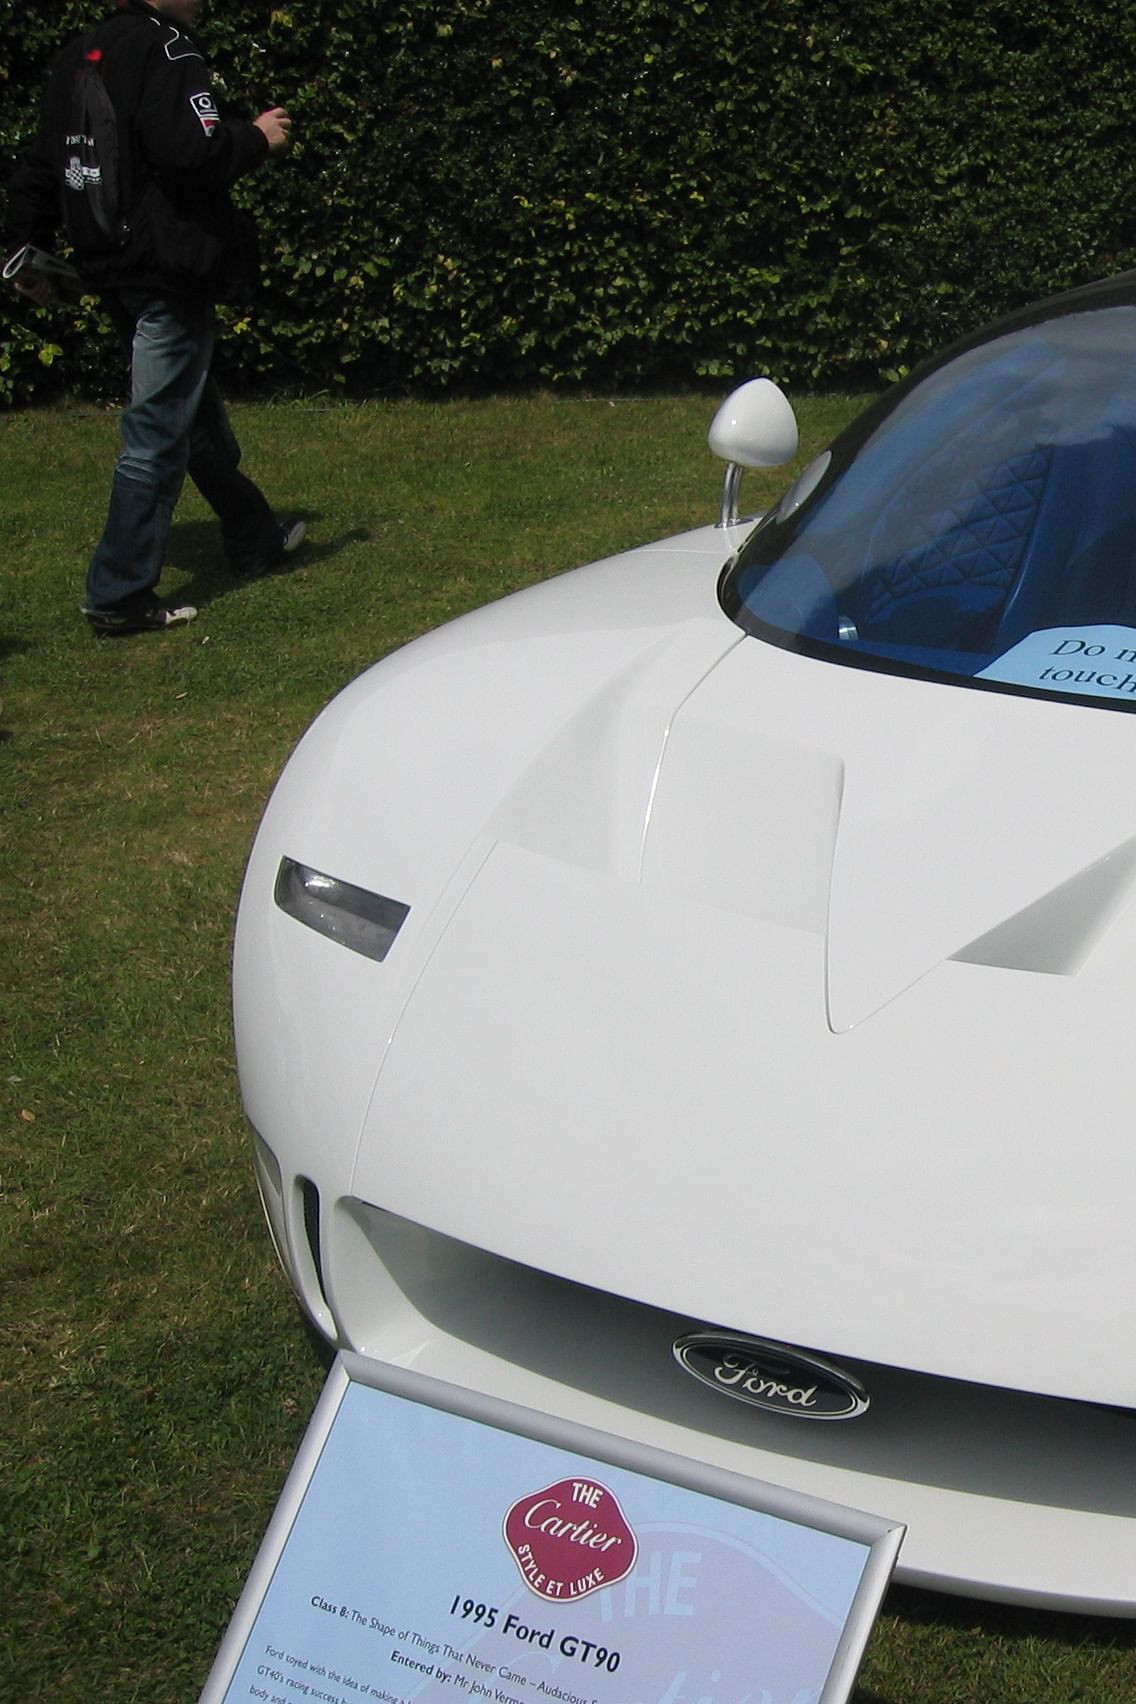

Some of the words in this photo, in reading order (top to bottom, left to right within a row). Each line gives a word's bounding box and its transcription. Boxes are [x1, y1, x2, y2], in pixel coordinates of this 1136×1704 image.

[1051, 639, 1106, 656] Do
[714, 1352, 818, 1407] Ford
[572, 1482, 604, 1508] THE
[524, 1499, 622, 1551] Cartier
[518, 1544, 546, 1588] STYLE
[545, 1580, 564, 1596] ET
[570, 1567, 605, 1596] LUXE
[311, 1595, 337, 1616] Class
[339, 1605, 350, 1618] 8:
[351, 1609, 367, 1626] The
[369, 1616, 396, 1637] Shape
[397, 1629, 410, 1640] of
[411, 1632, 440, 1654] Things
[442, 1644, 464, 1664] That
[465, 1653, 496, 1673] Never
[499, 1667, 526, 1686] Came
[450, 1595, 499, 1628] 1995
[502, 1614, 555, 1649] Ford
[559, 1636, 621, 1673] GT90
[249, 1684, 269, 1702] body
[265, 1645, 284, 1660] Ford
[285, 1653, 308, 1670] toyed
[309, 1662, 326, 1677] with
[328, 1669, 342, 1683] the
[343, 1675, 358, 1690] idea
[360, 1683, 370, 1693] of
[286, 1678, 309, 1696] racing
[391, 1650, 434, 1676] Entered
[435, 1667, 452, 1683] by:
[454, 1674, 469, 1688] Mr
[469, 1681, 492, 1698] John
